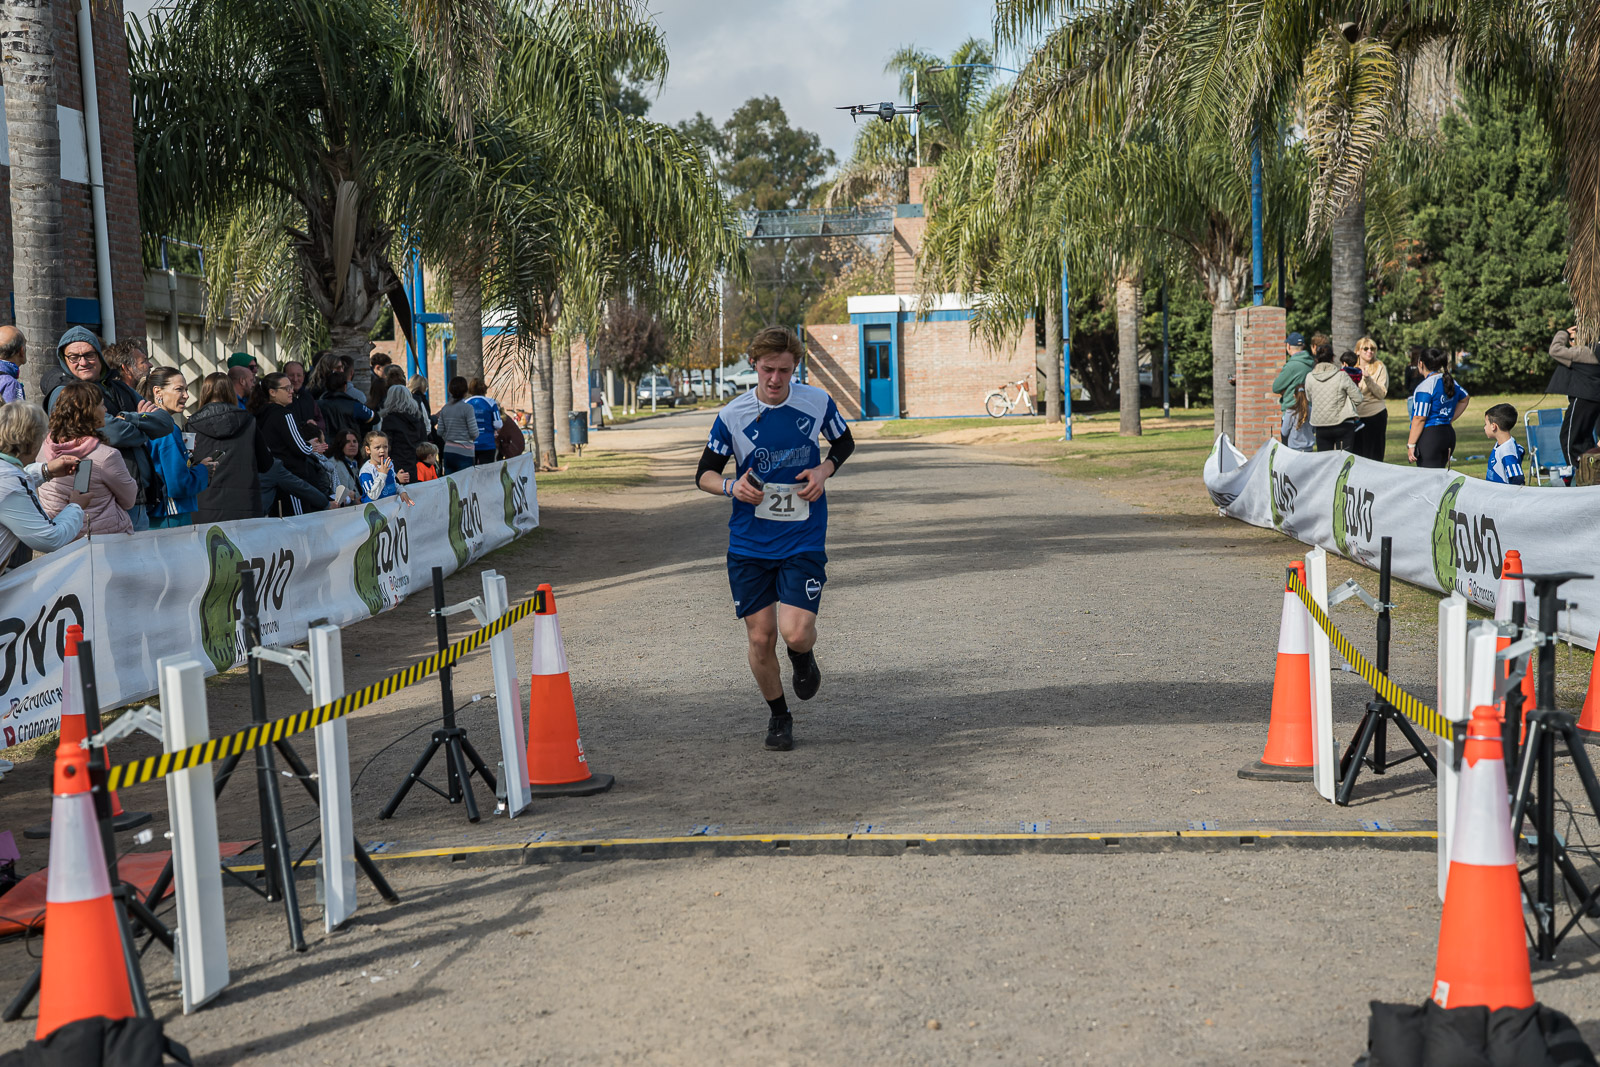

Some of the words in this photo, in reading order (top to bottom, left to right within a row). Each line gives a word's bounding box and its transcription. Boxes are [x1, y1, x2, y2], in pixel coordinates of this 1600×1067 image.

[754, 447, 770, 473] 3
[768, 493, 795, 511] 21
[18, 716, 60, 743] cronorav
